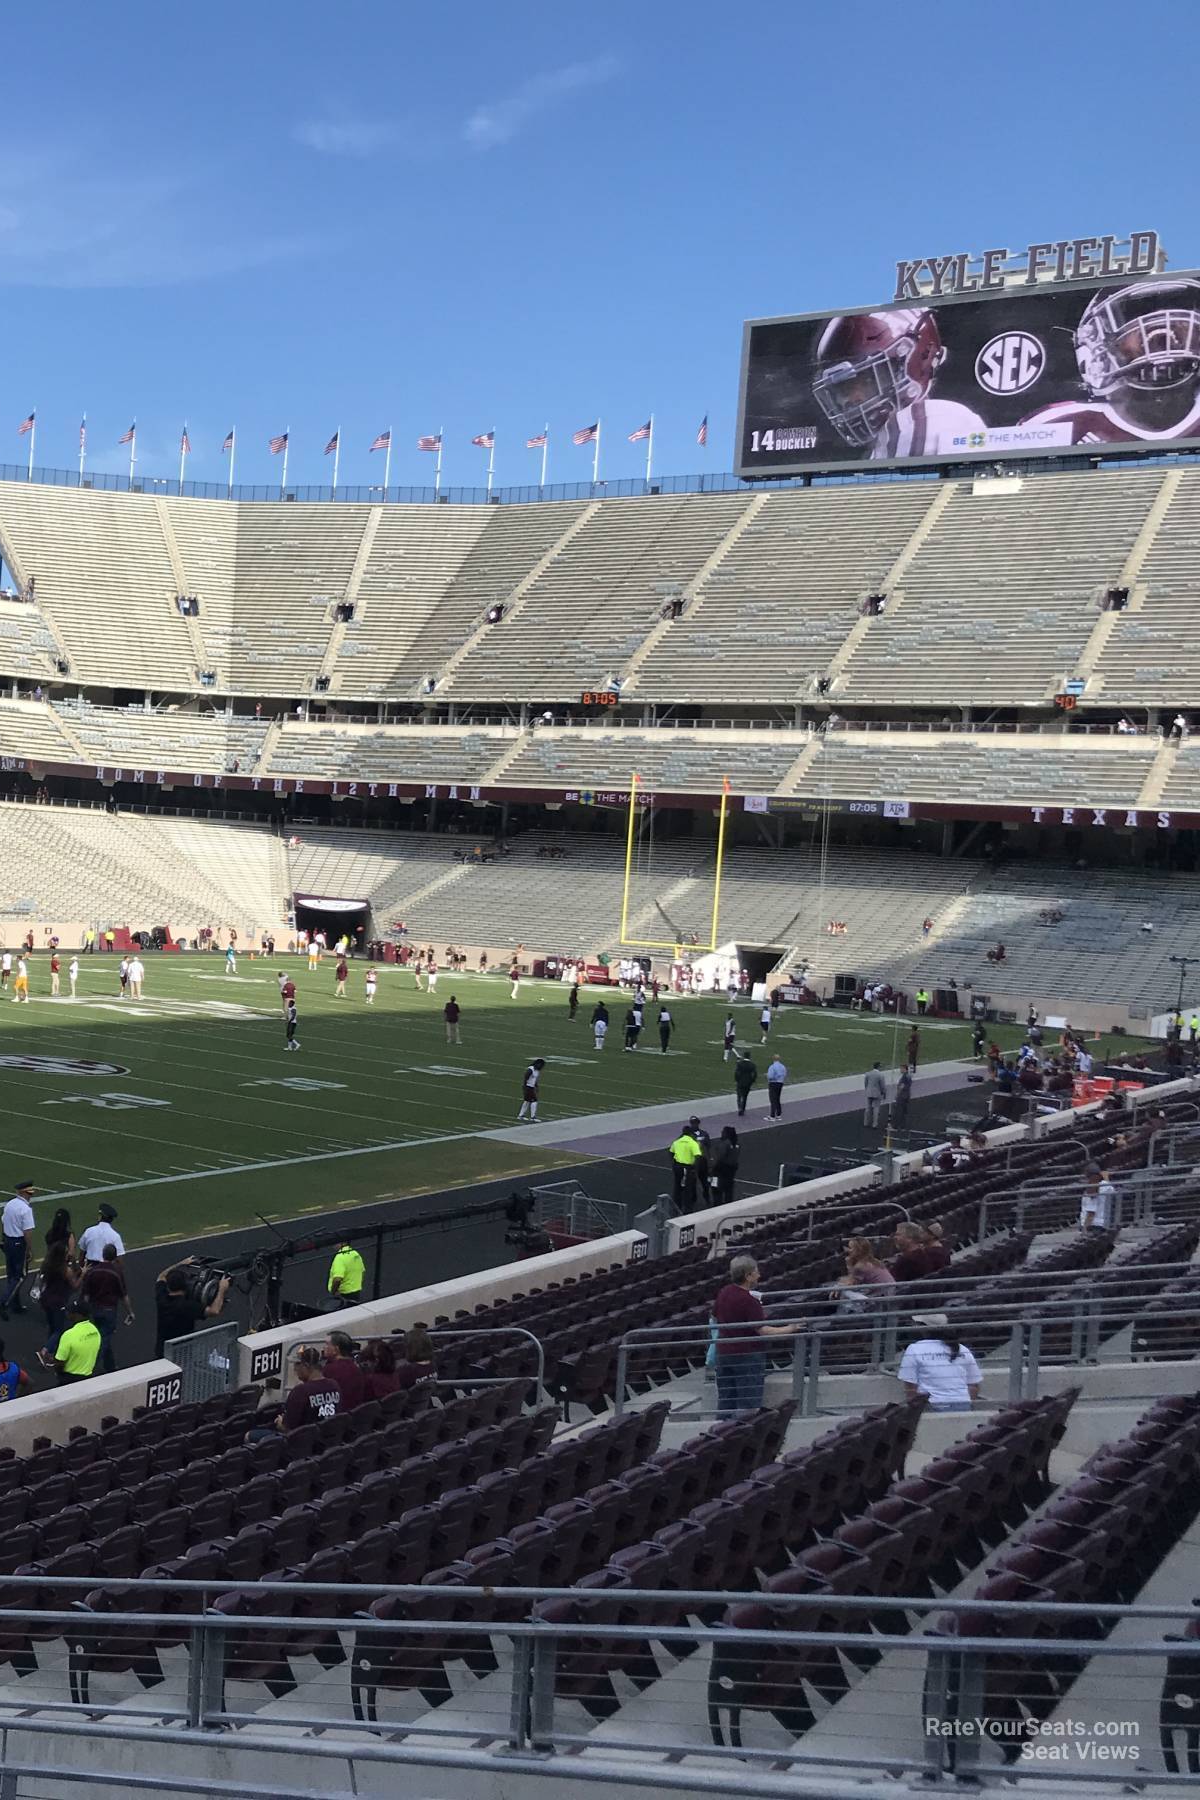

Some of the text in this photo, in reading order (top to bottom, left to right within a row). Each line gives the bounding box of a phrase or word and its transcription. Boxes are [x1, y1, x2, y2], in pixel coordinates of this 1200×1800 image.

[894, 230, 1158, 300] KYLE FIELD
[979, 334, 1041, 391] SEC
[751, 429, 774, 452] 14
[775, 437, 817, 450] BUCKLEY
[953, 430, 1053, 446] BE THE MATCH
[96, 766, 480, 800] HOME OF THE 12TH MAN
[565, 792, 578, 801] BE
[597, 793, 615, 802] THE
[849, 802, 877, 813] 87:05
[1031, 807, 1170, 828] TEXAS
[61, 1092, 173, 1110] 20
[254, 1350, 280, 1376] FB11
[148, 1379, 181, 1408] FB12
[309, 1391, 340, 1408] RELOAD
[318, 1403, 336, 1417] AGS
